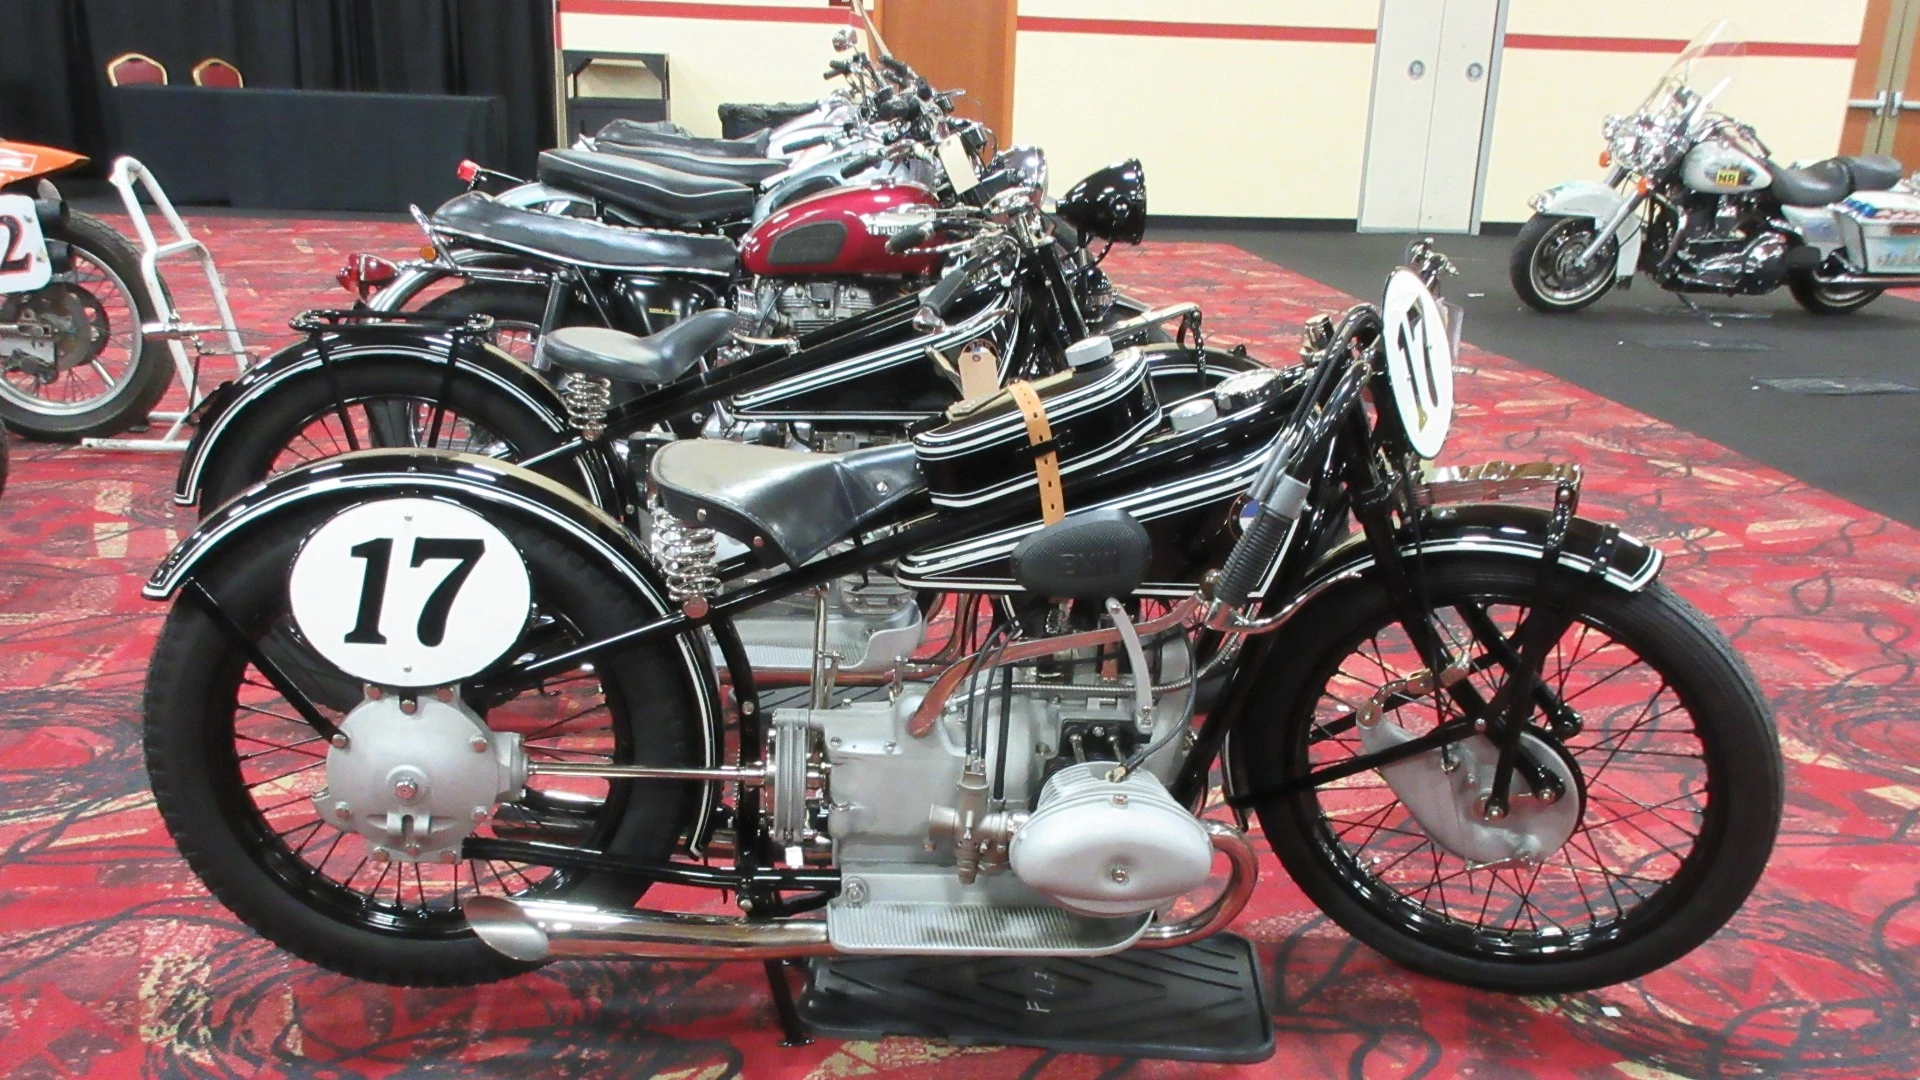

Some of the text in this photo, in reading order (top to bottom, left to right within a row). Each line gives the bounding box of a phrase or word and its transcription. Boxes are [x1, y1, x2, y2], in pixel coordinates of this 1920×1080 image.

[0, 214, 32, 275] 2
[867, 224, 915, 236] TRIUM
[1397, 294, 1438, 432] 17
[344, 536, 486, 647] 17
